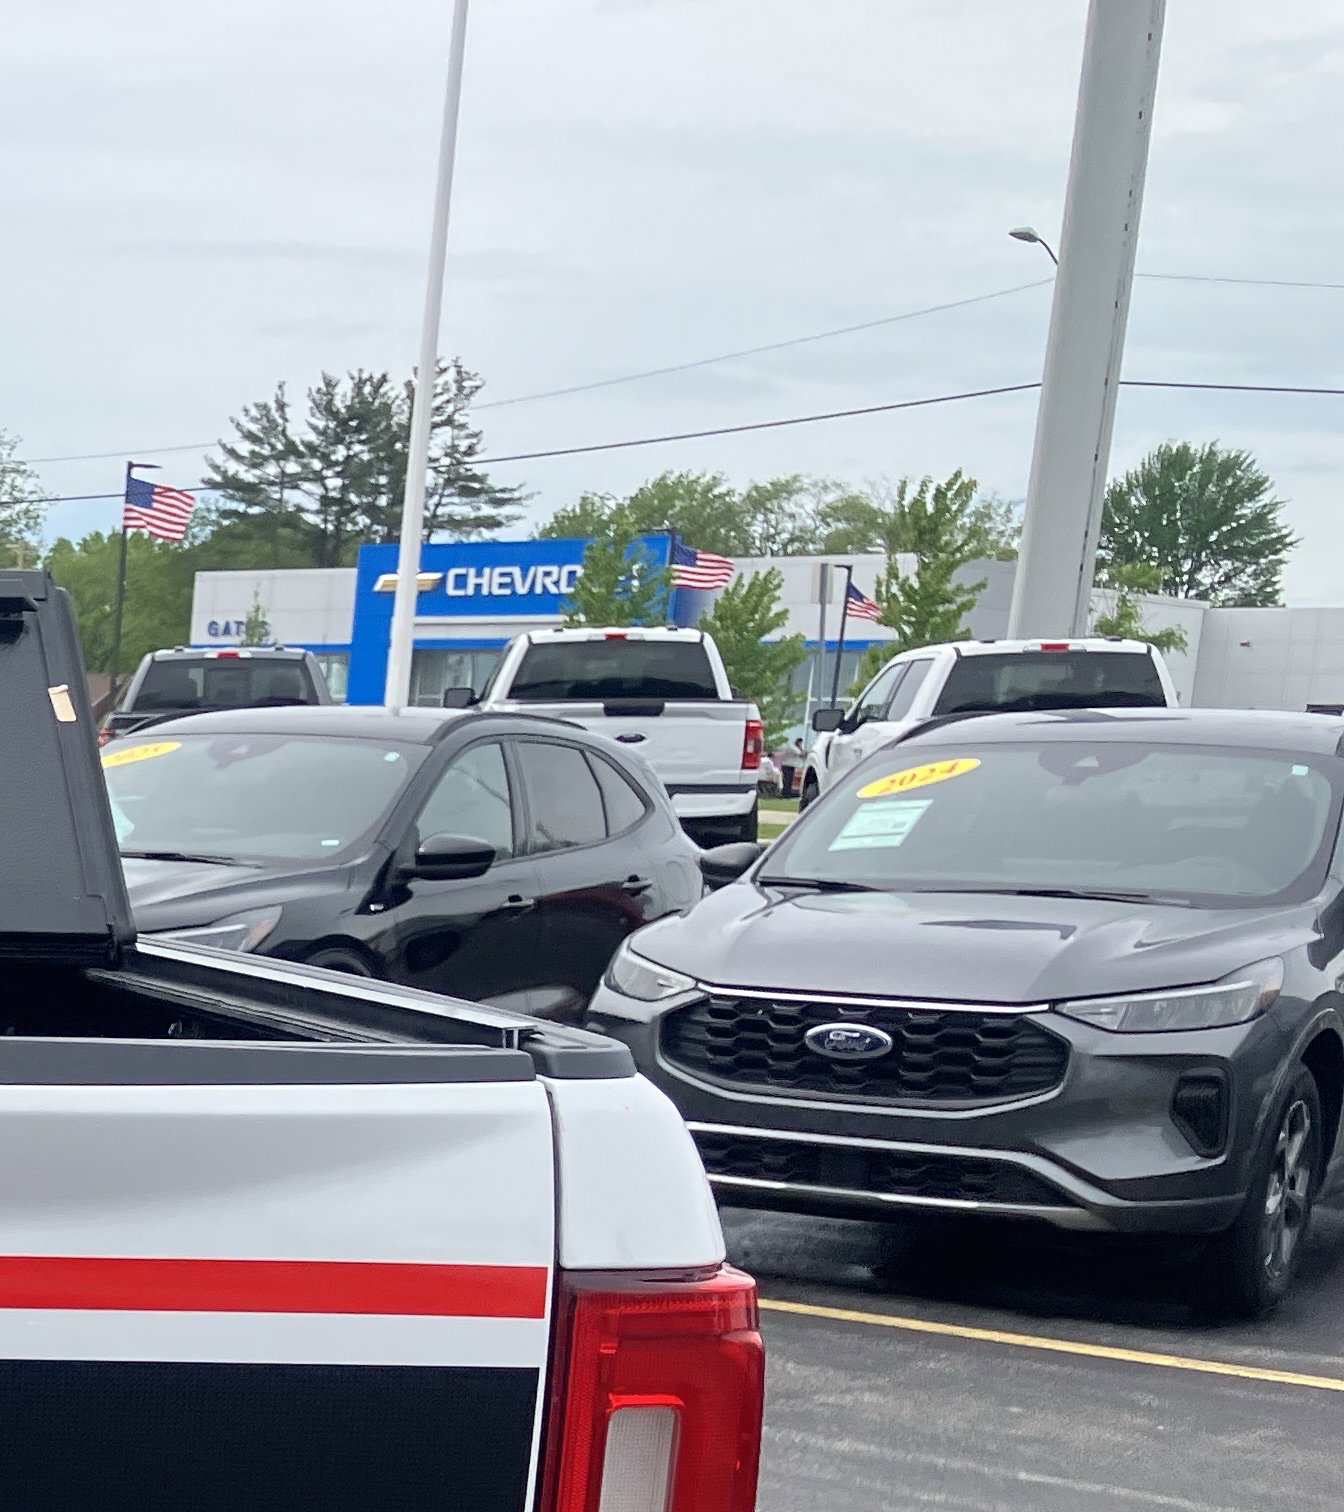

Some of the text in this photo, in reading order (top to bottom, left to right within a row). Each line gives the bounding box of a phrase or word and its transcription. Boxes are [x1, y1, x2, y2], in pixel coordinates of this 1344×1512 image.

[445, 563, 646, 597] CHEVRO
[878, 761, 959, 793] 2024
[825, 1030, 871, 1051] Ford
